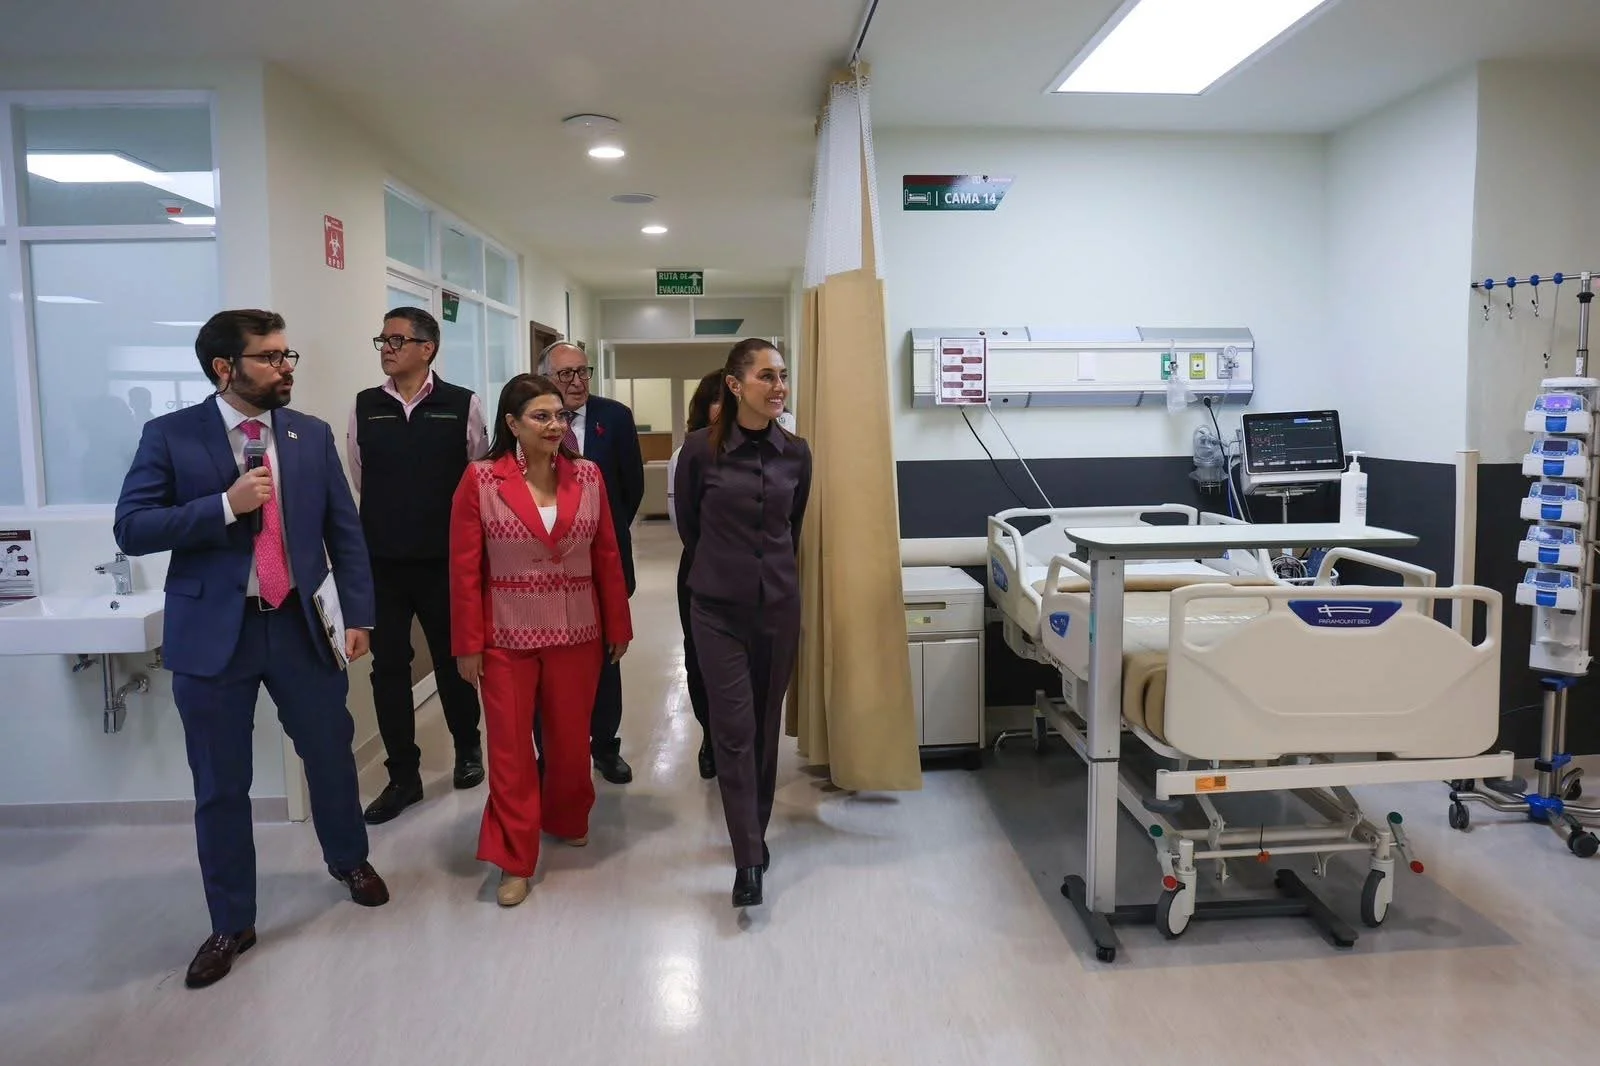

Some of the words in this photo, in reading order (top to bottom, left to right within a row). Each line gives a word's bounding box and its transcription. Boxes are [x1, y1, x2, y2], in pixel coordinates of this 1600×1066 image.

[944, 192, 980, 205] CAMA
[983, 192, 997, 205] 14
[659, 272, 678, 280] RUTA
